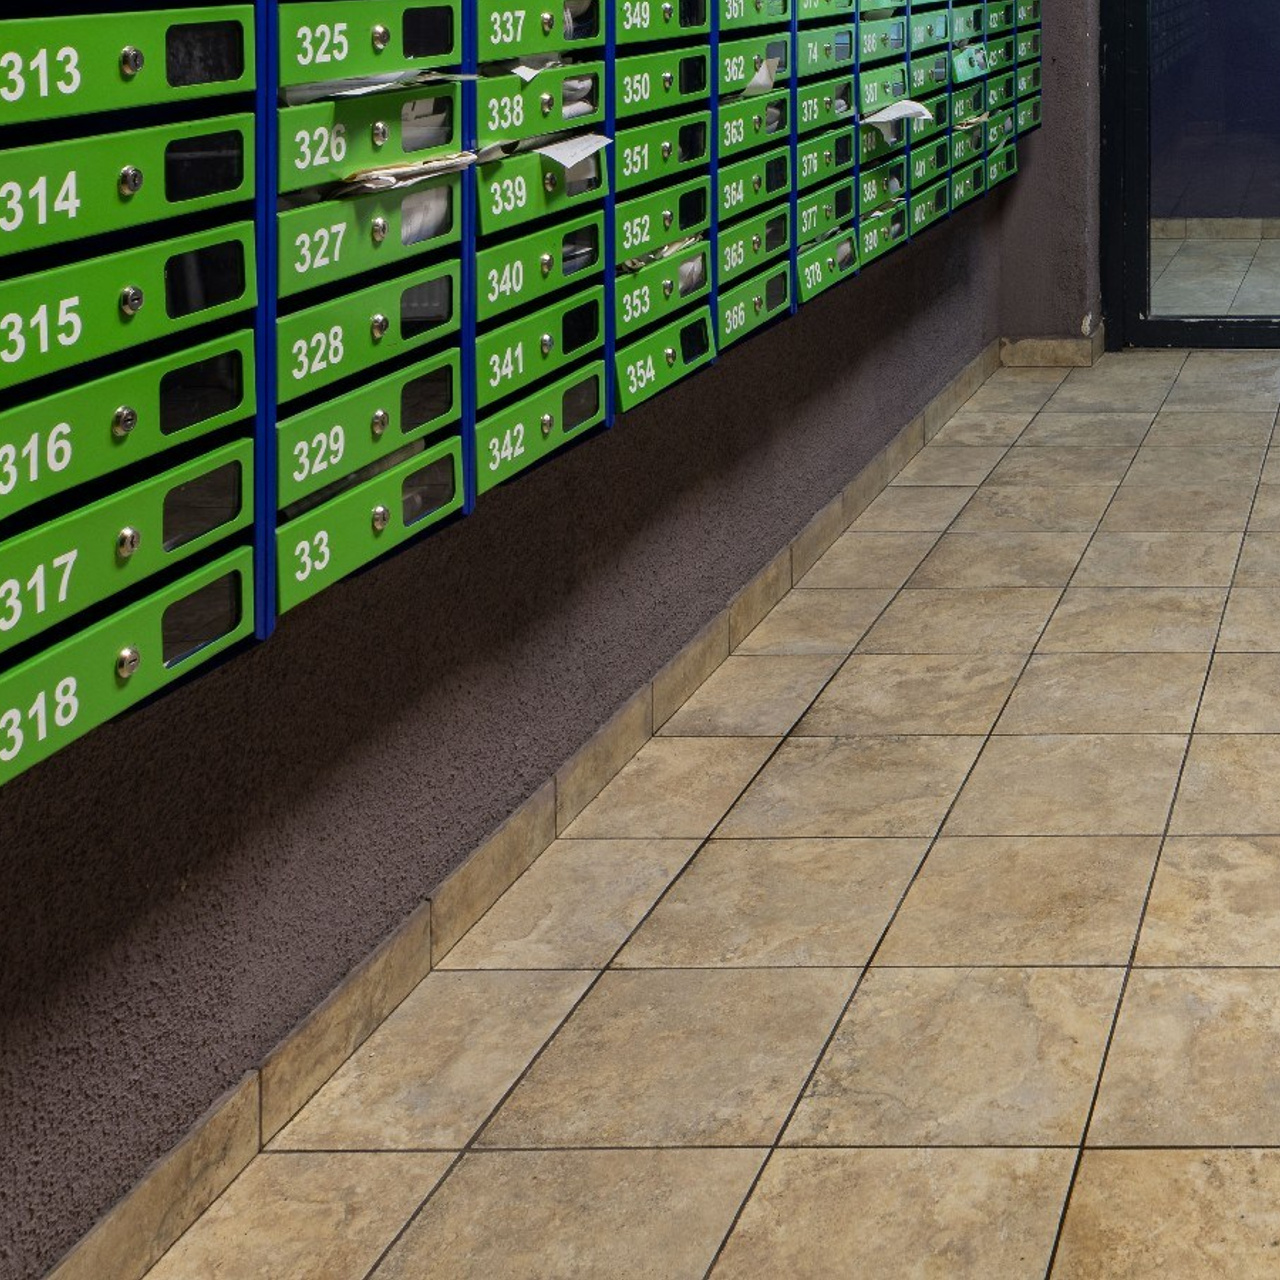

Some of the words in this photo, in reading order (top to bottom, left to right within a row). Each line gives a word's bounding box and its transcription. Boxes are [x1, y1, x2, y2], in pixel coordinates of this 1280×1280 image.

[491, 10, 525, 44] 337
[623, 2, 650, 29] 349
[297, 23, 348, 65] 325
[808, 42, 818, 63] 74
[0, 47, 81, 102] 313
[725, 56, 745, 82] 362
[623, 73, 650, 103] 350
[488, 94, 524, 130] 338
[802, 98, 818, 122] 375
[295, 127, 346, 169] 326
[724, 119, 744, 146] 363
[623, 144, 648, 176] 351
[802, 152, 817, 177] 376
[0, 171, 80, 231] 314
[491, 176, 526, 214] 339
[724, 180, 744, 208] 364
[623, 215, 650, 249] 352
[802, 205, 817, 233] 377
[295, 222, 346, 272] 327
[724, 241, 744, 271] 365
[488, 261, 523, 302] 340
[805, 262, 822, 289] 378
[623, 286, 649, 322] 353
[725, 302, 745, 334] 366
[0, 296, 82, 362] 315
[292, 326, 343, 379] 328
[490, 342, 523, 387] 341
[627, 355, 655, 393] 354
[0, 423, 72, 494] 316
[293, 426, 344, 481] 329
[489, 423, 524, 470] 342
[295, 531, 330, 581] 33
[0, 549, 77, 631] 317
[0, 677, 79, 761] 318
